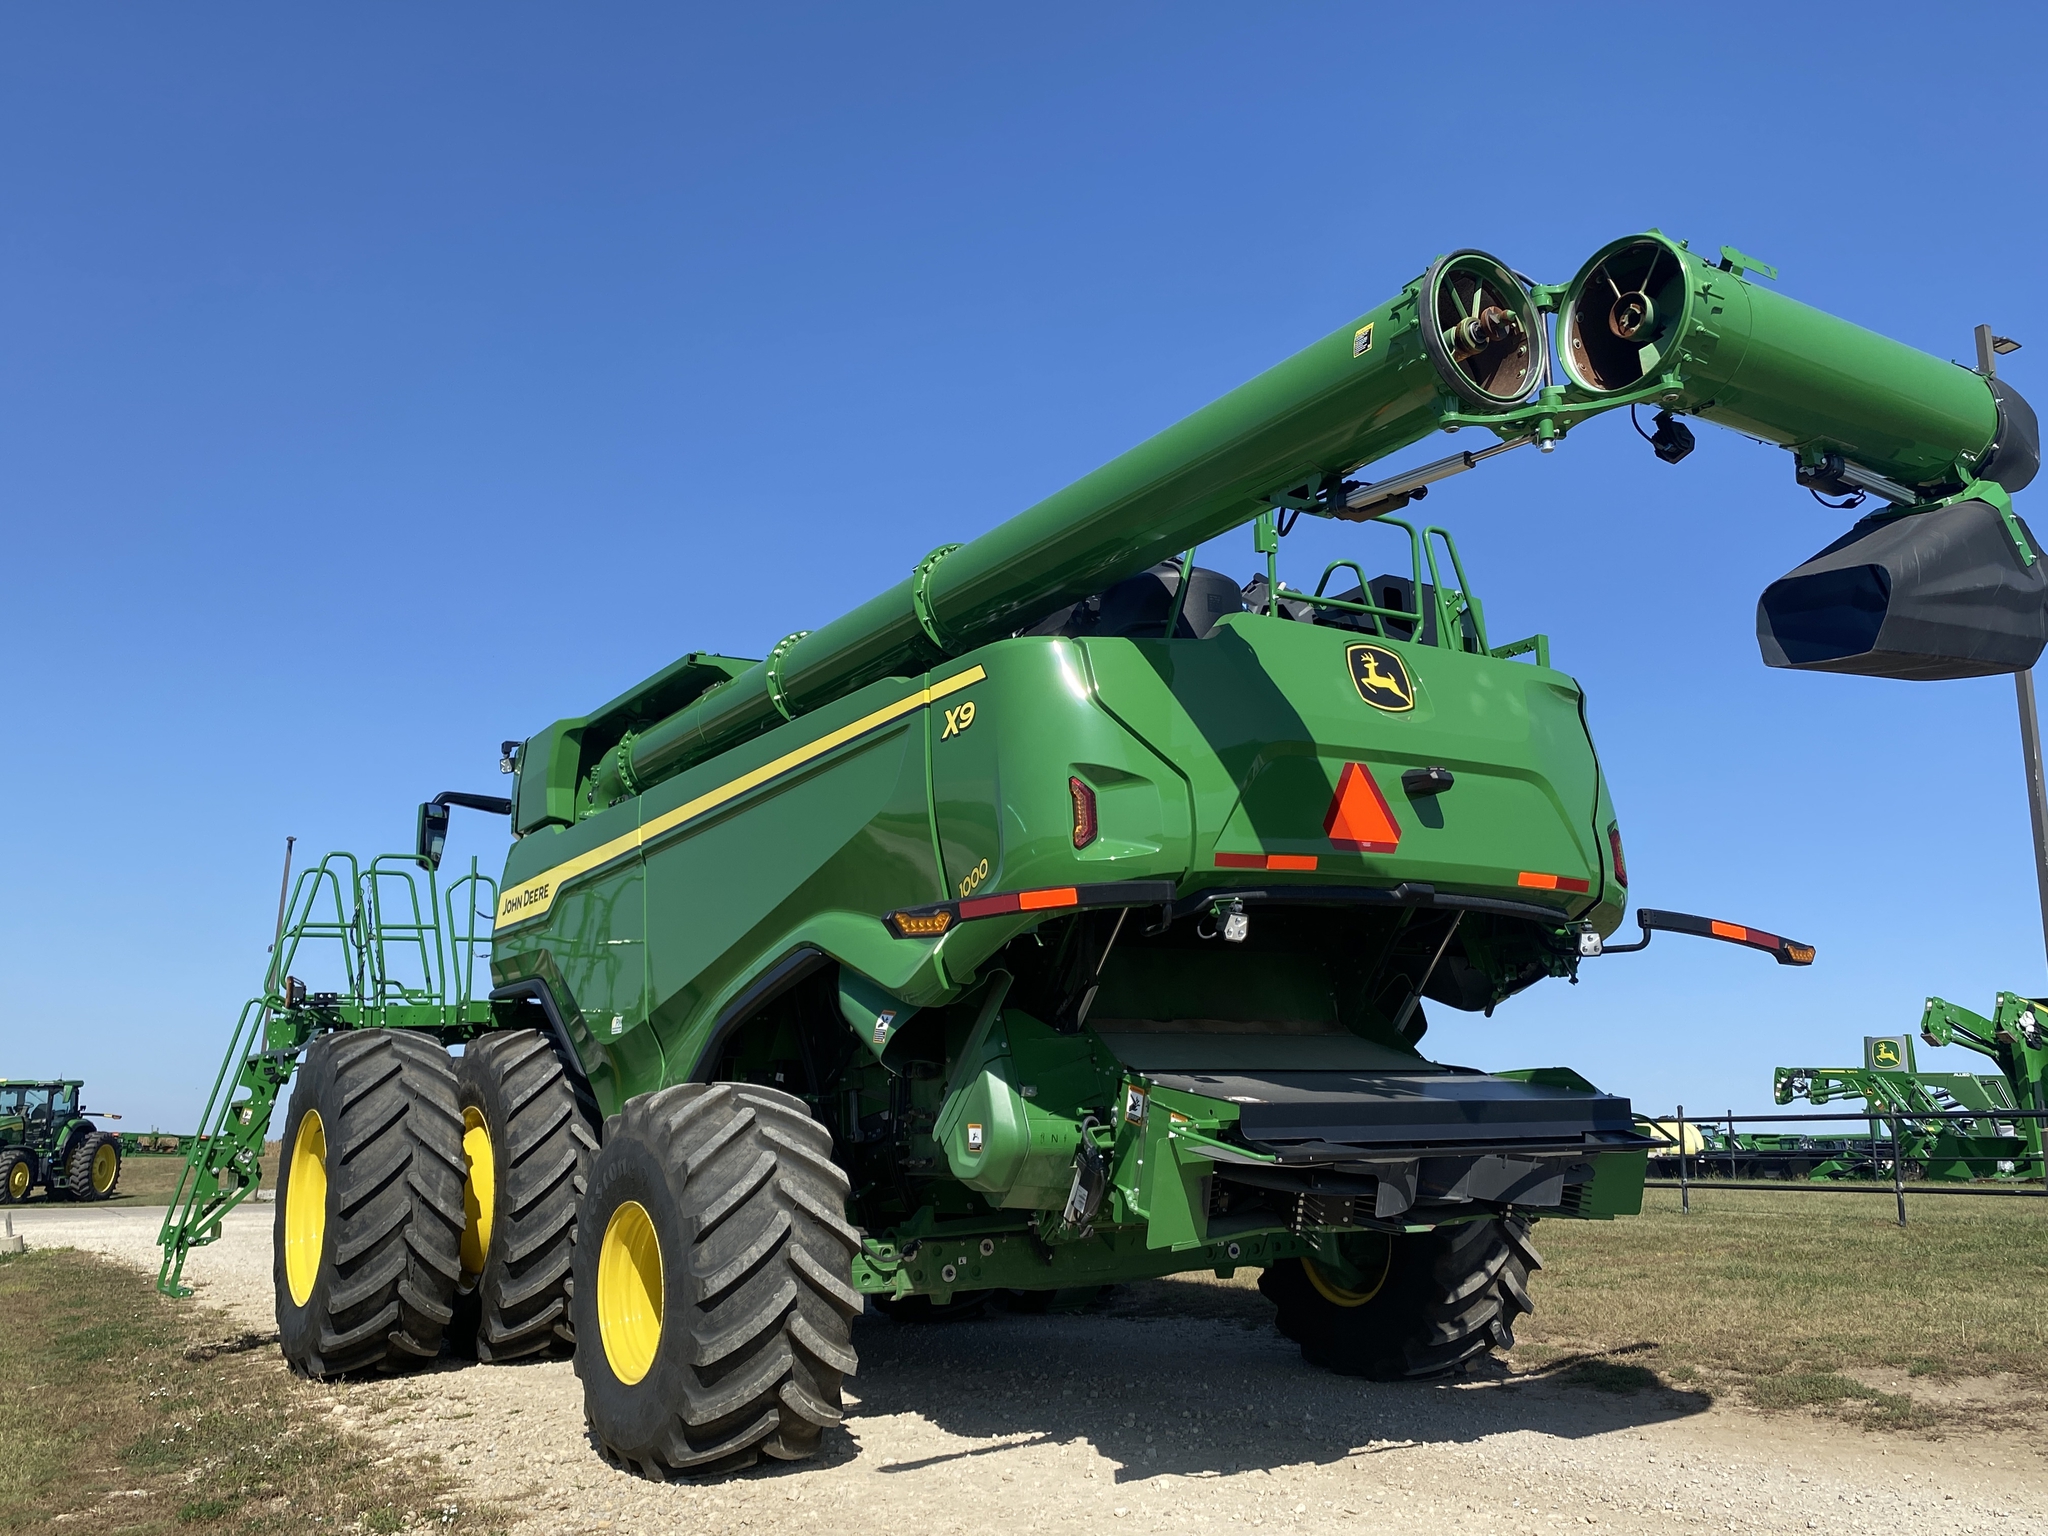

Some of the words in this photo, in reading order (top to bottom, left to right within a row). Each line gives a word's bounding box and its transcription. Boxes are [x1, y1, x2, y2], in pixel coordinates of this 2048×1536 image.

[941, 700, 976, 742] X9
[958, 858, 988, 898] 1000
[502, 895, 522, 915] JOHN
[523, 883, 549, 907] DEERE
